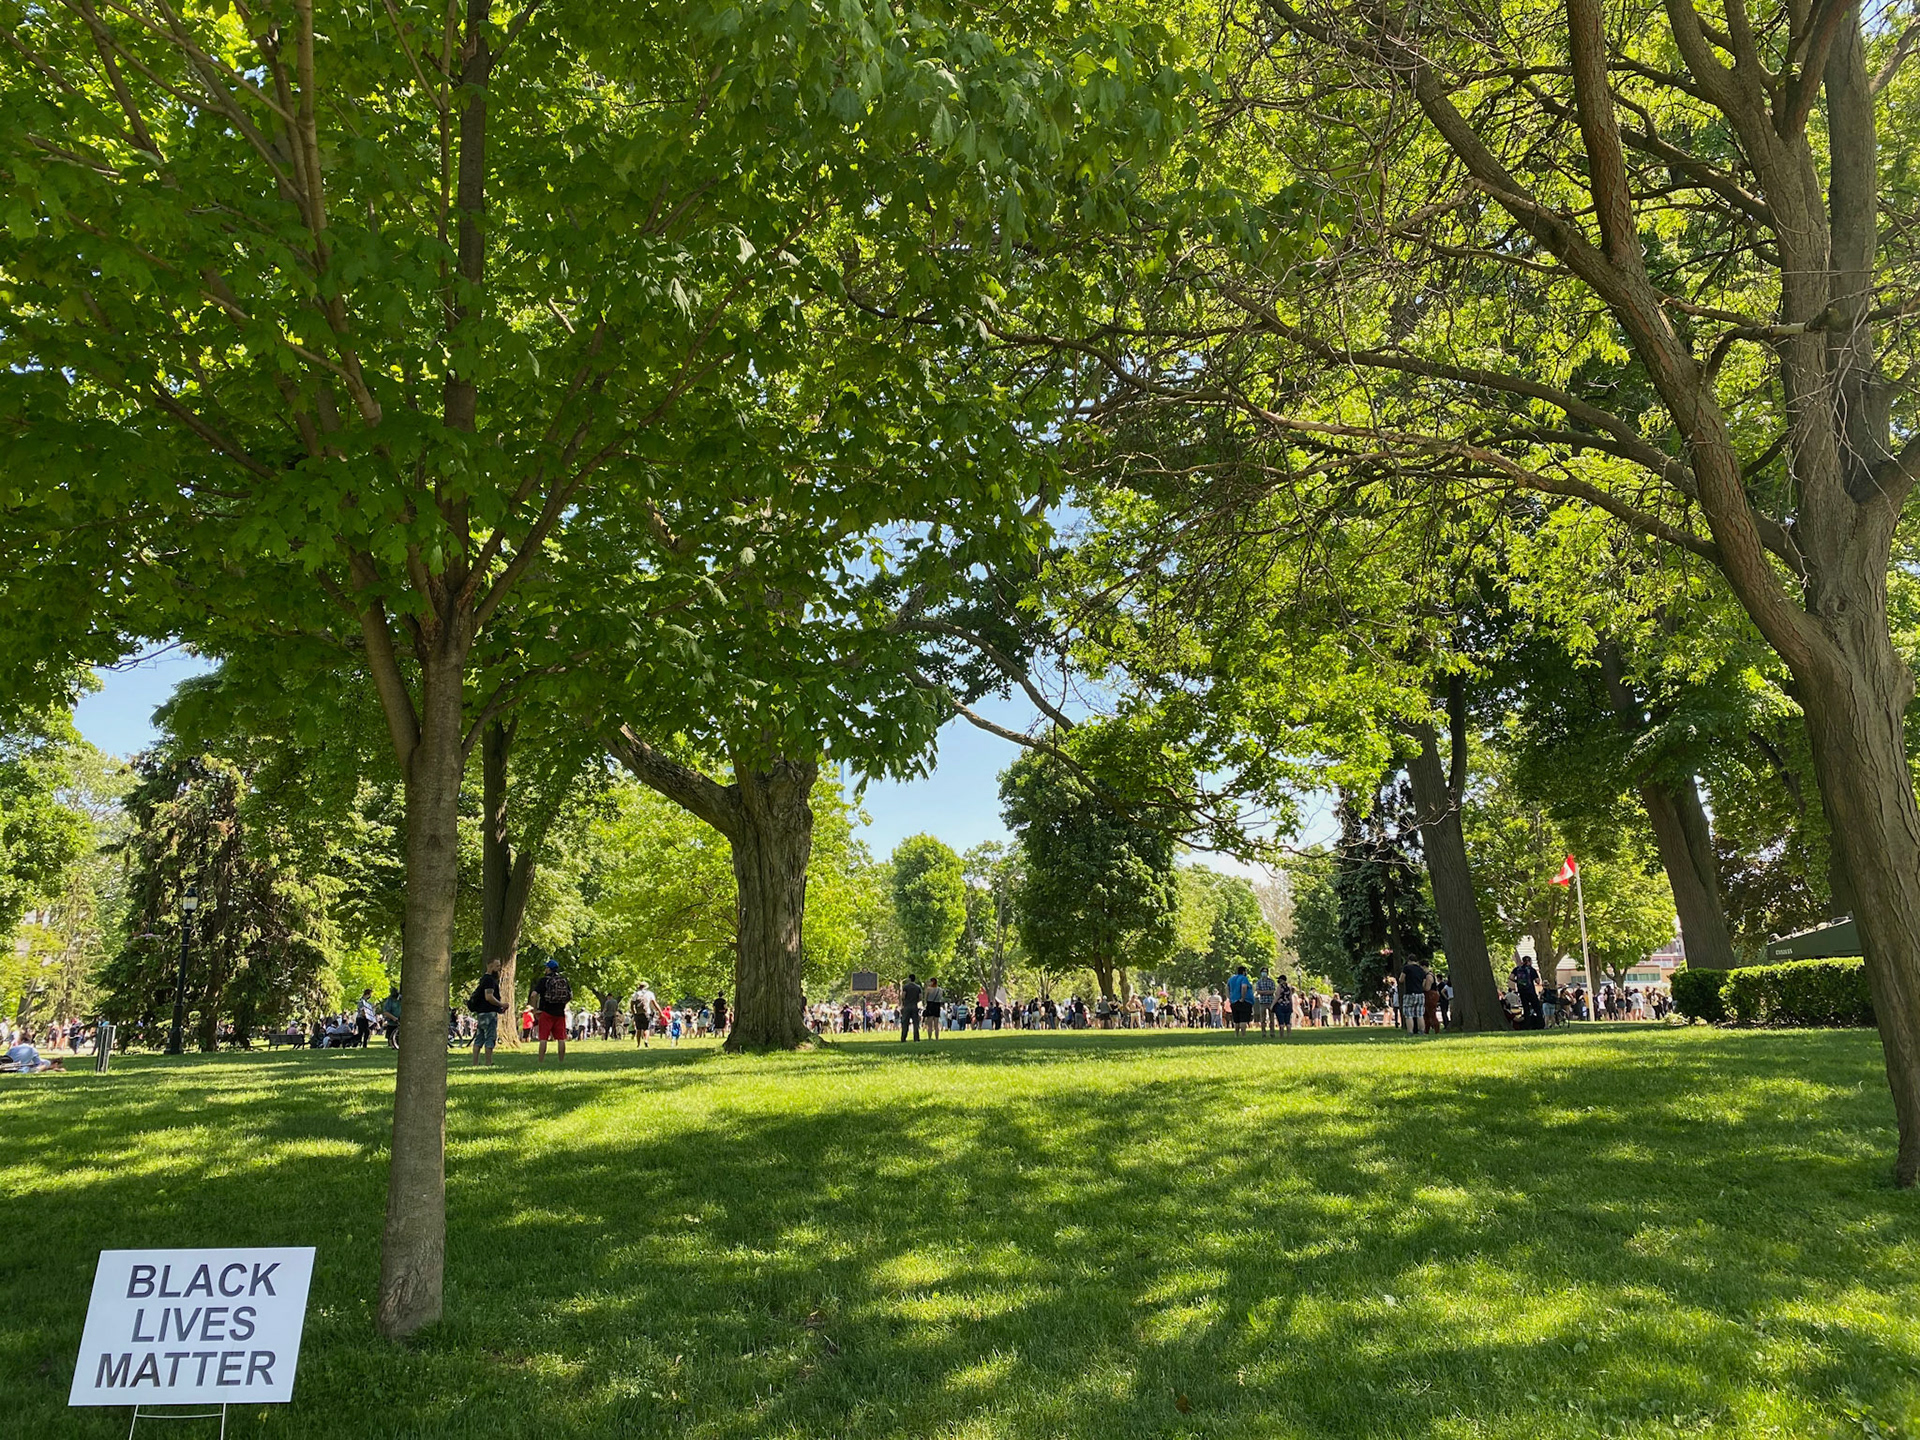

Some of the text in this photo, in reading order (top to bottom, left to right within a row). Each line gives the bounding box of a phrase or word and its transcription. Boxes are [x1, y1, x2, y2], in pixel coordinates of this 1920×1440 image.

[127, 1263, 281, 1298] BLACK
[131, 1307, 256, 1342] LIVES
[95, 1351, 276, 1388] MATTER
